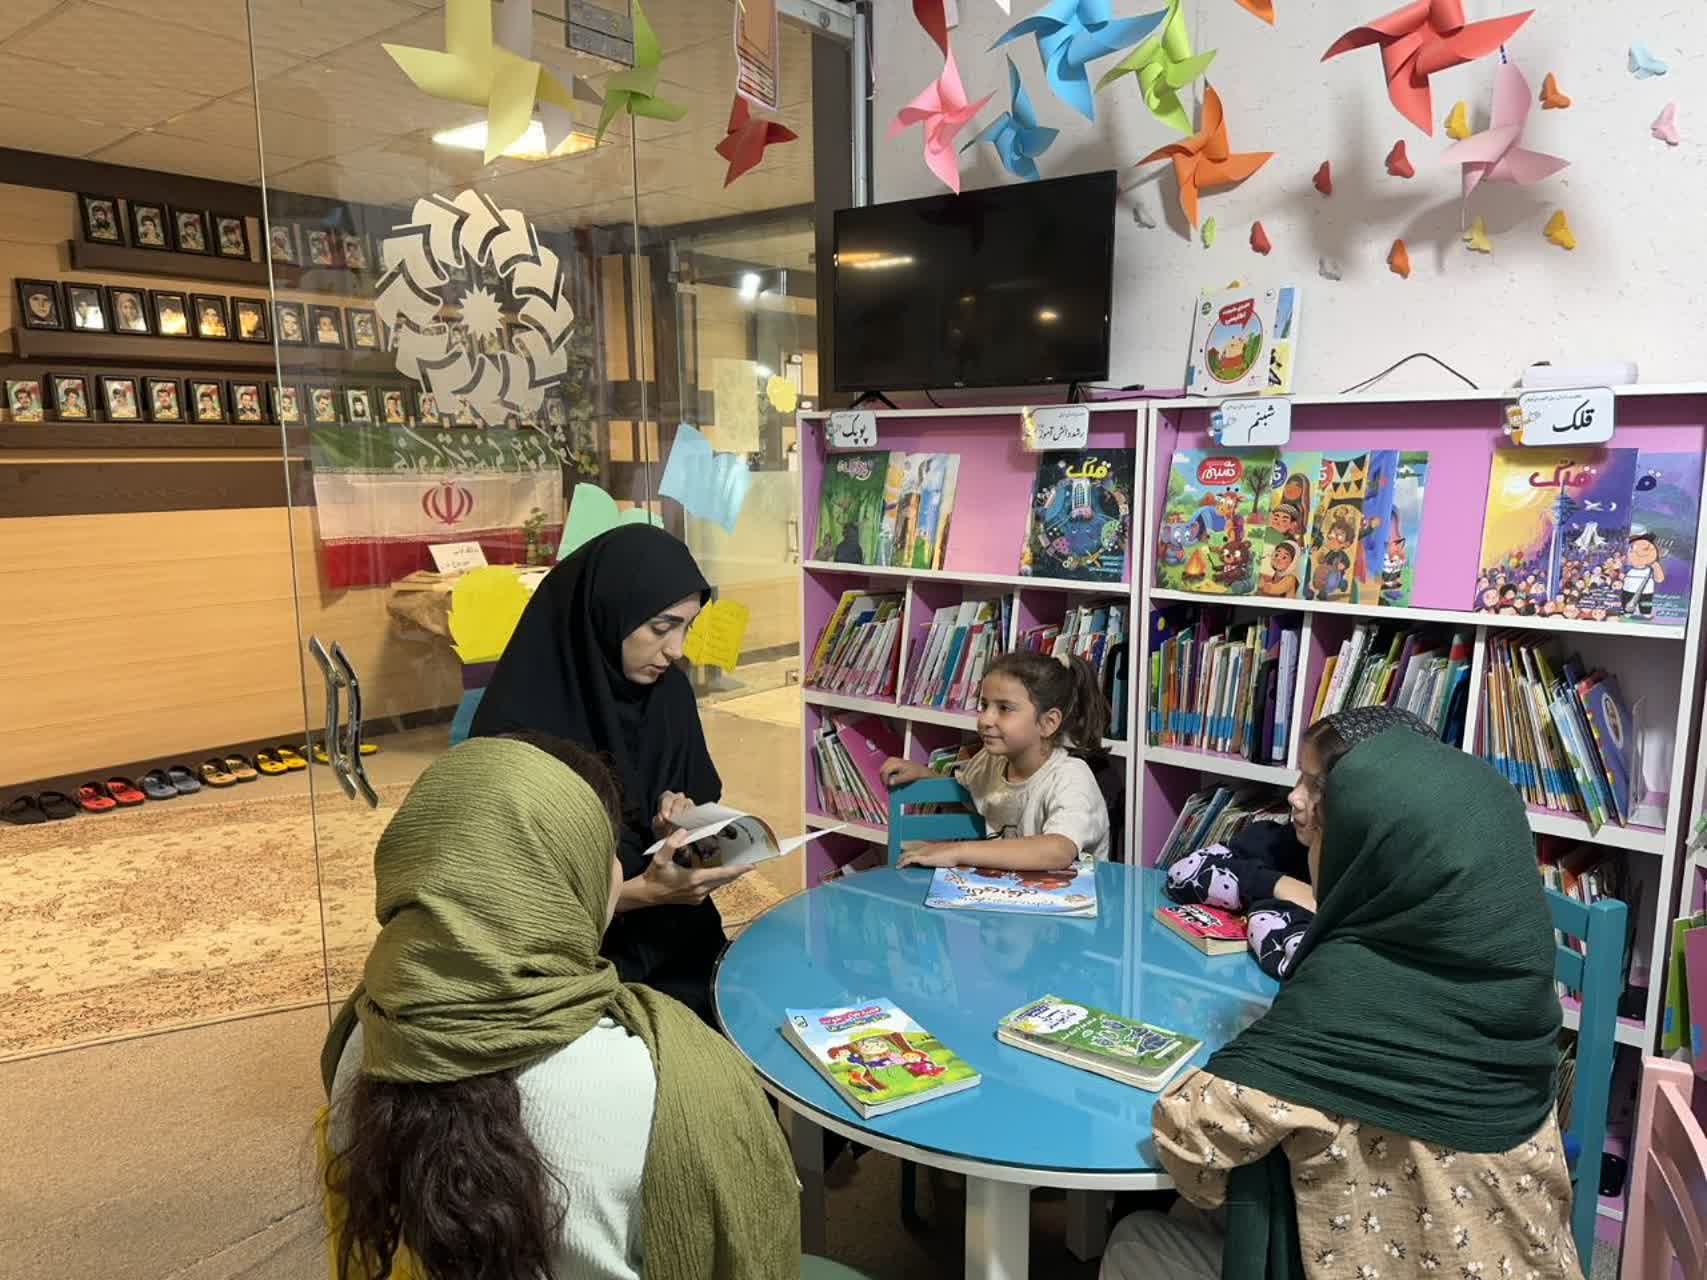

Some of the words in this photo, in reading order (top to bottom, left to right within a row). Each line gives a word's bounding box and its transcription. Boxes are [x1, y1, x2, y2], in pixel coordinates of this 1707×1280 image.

[842, 413, 869, 445] پوپک
[1247, 404, 1276, 443] شبنم
[1552, 399, 1595, 433] قلک
